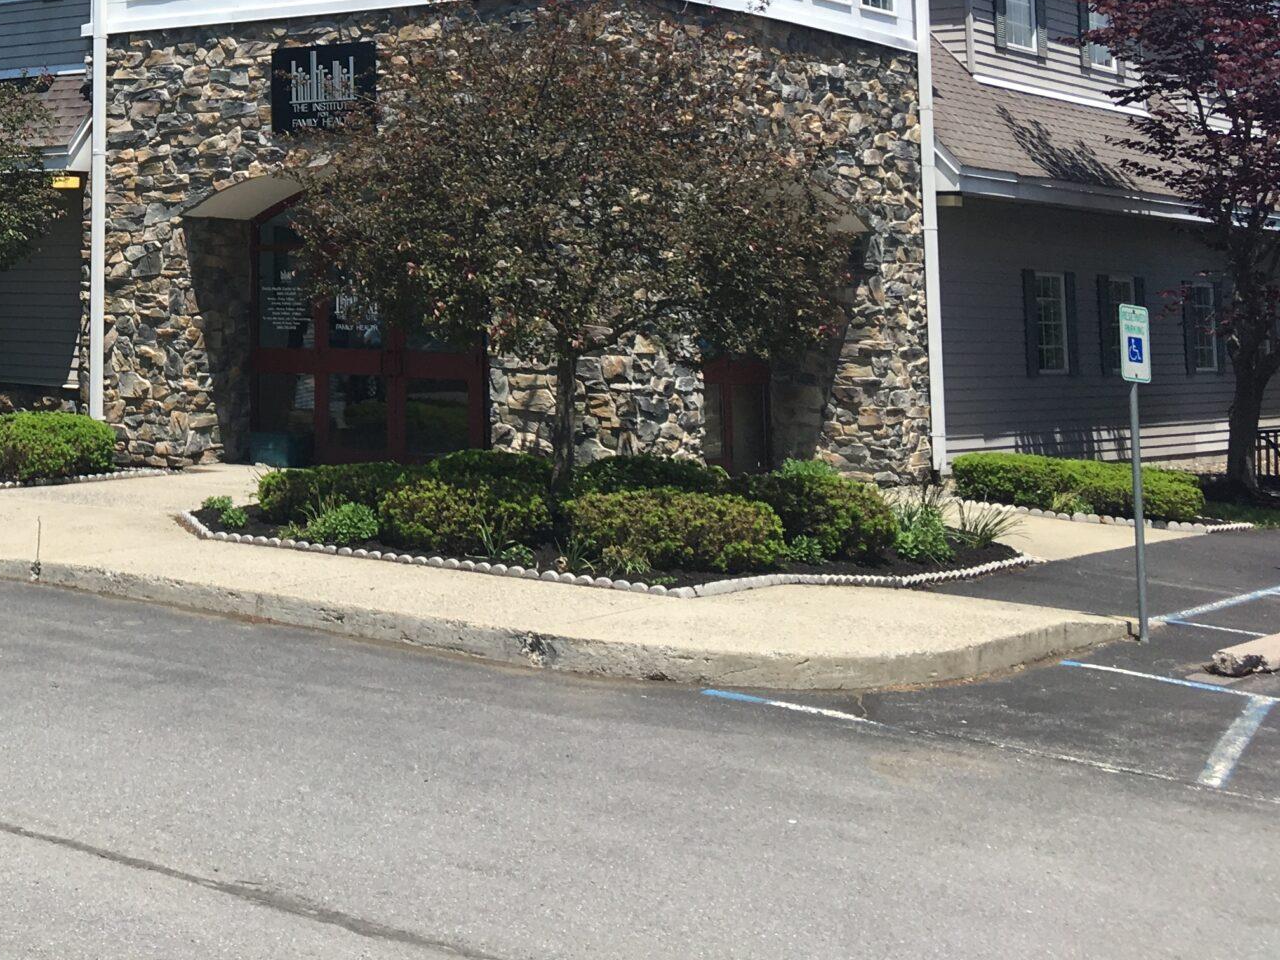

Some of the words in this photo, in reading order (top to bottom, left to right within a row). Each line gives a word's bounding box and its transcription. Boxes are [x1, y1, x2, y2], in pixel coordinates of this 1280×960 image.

[292, 103, 308, 113] THE
[312, 102, 349, 112] INSTITUT
[292, 118, 319, 127] FAMILY
[322, 116, 348, 127] HEALT
[336, 323, 354, 331] FAMILY
